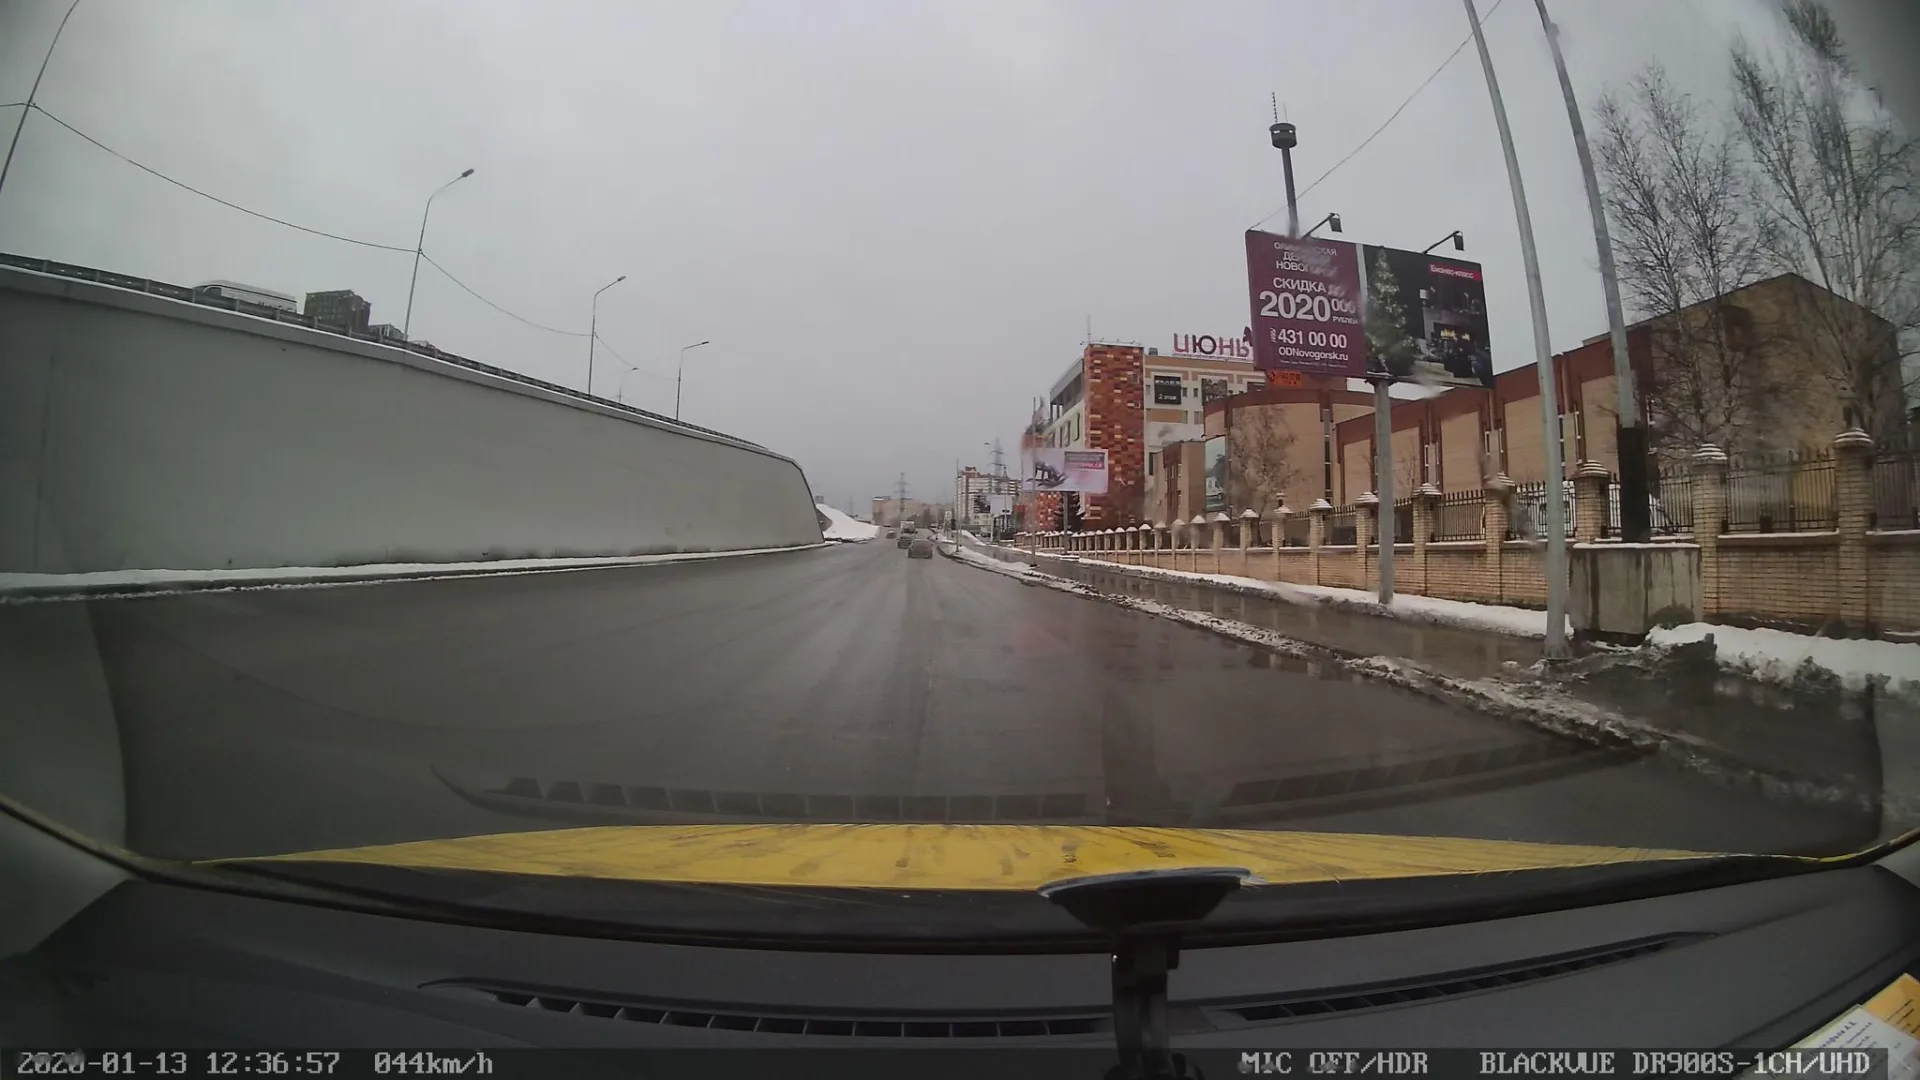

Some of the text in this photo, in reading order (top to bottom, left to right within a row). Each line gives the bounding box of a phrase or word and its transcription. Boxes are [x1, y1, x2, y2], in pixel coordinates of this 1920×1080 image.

[1273, 276, 1327, 293] СКИДКА
[1259, 290, 1331, 322] 2020
[1278, 328, 1303, 345] 431
[1308, 331, 1327, 347] 00
[1329, 333, 1347, 349] 00
[1278, 346, 1348, 361] ODNovogorsk.ru
